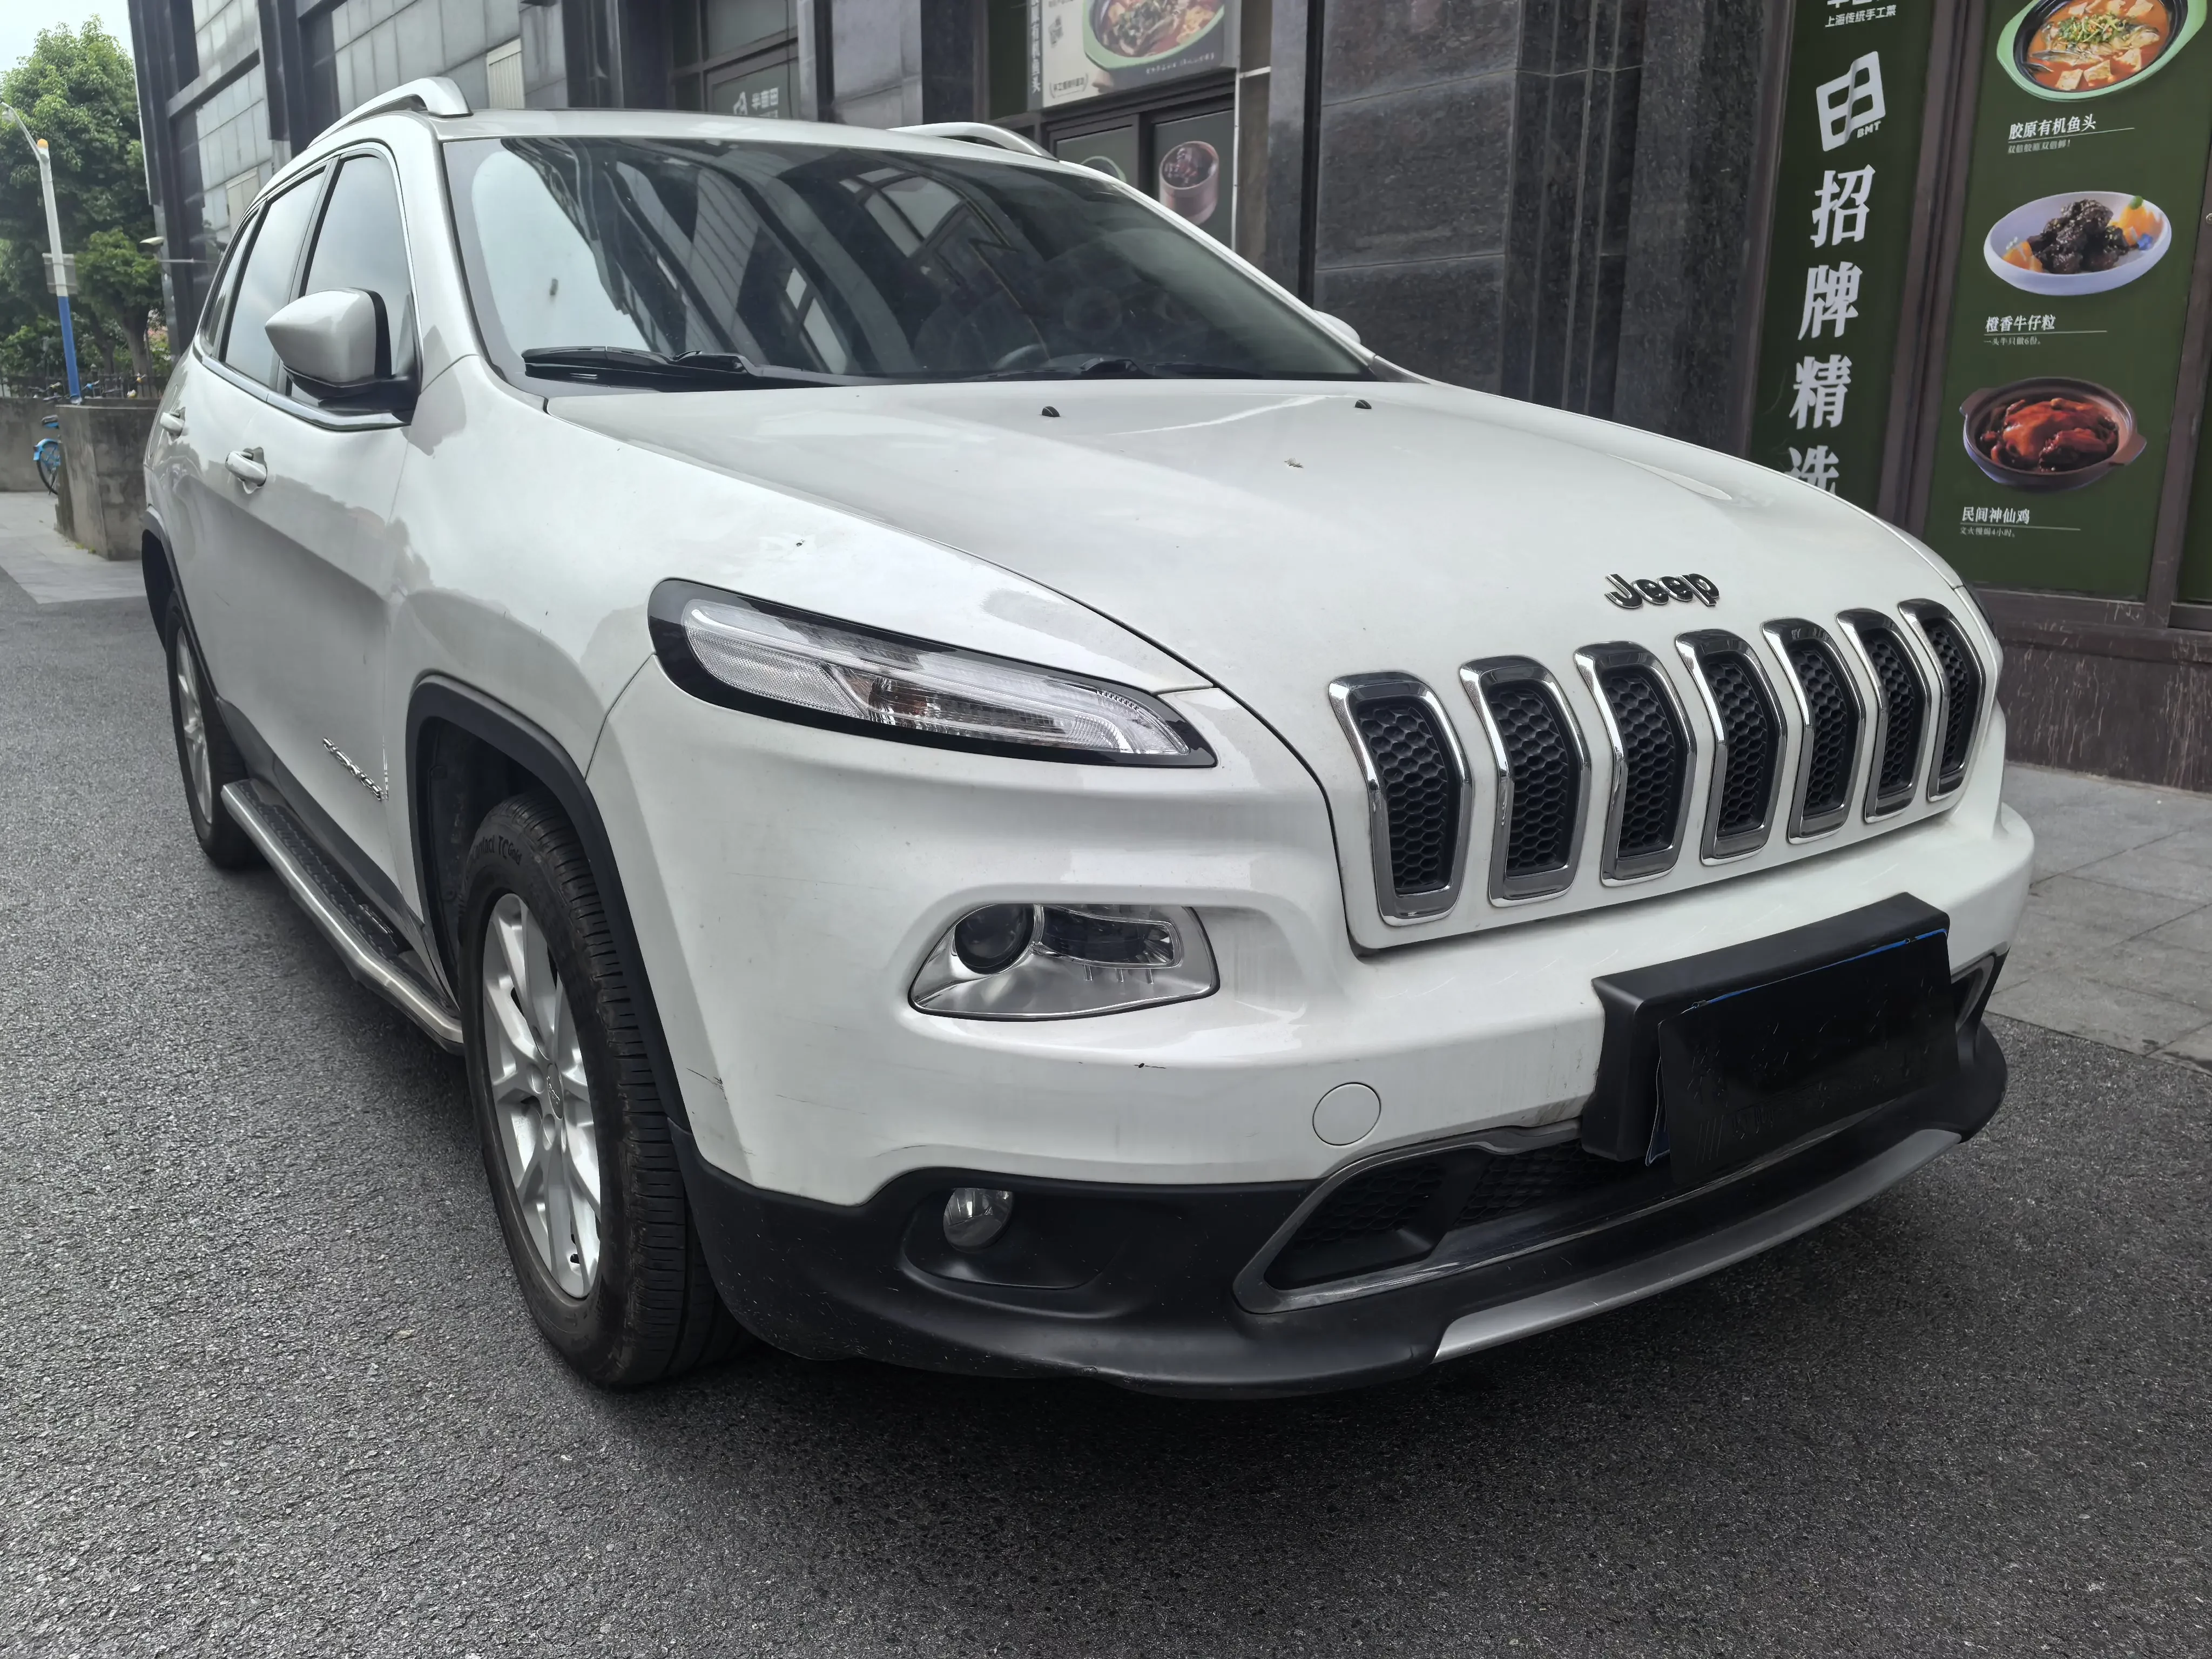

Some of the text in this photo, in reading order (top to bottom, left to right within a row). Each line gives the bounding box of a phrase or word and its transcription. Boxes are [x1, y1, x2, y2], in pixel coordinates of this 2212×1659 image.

[1825, 5, 1897, 28] 上海传统手工菜
[1857, 120, 1881, 139] BMT
[2008, 113, 2096, 140] 胶原有机鱼头
[1985, 314, 2056, 333] 橙香牛仔粒
[1961, 507, 2030, 525] 民间神仙鸡
[1604, 573, 1720, 610] Jeep
